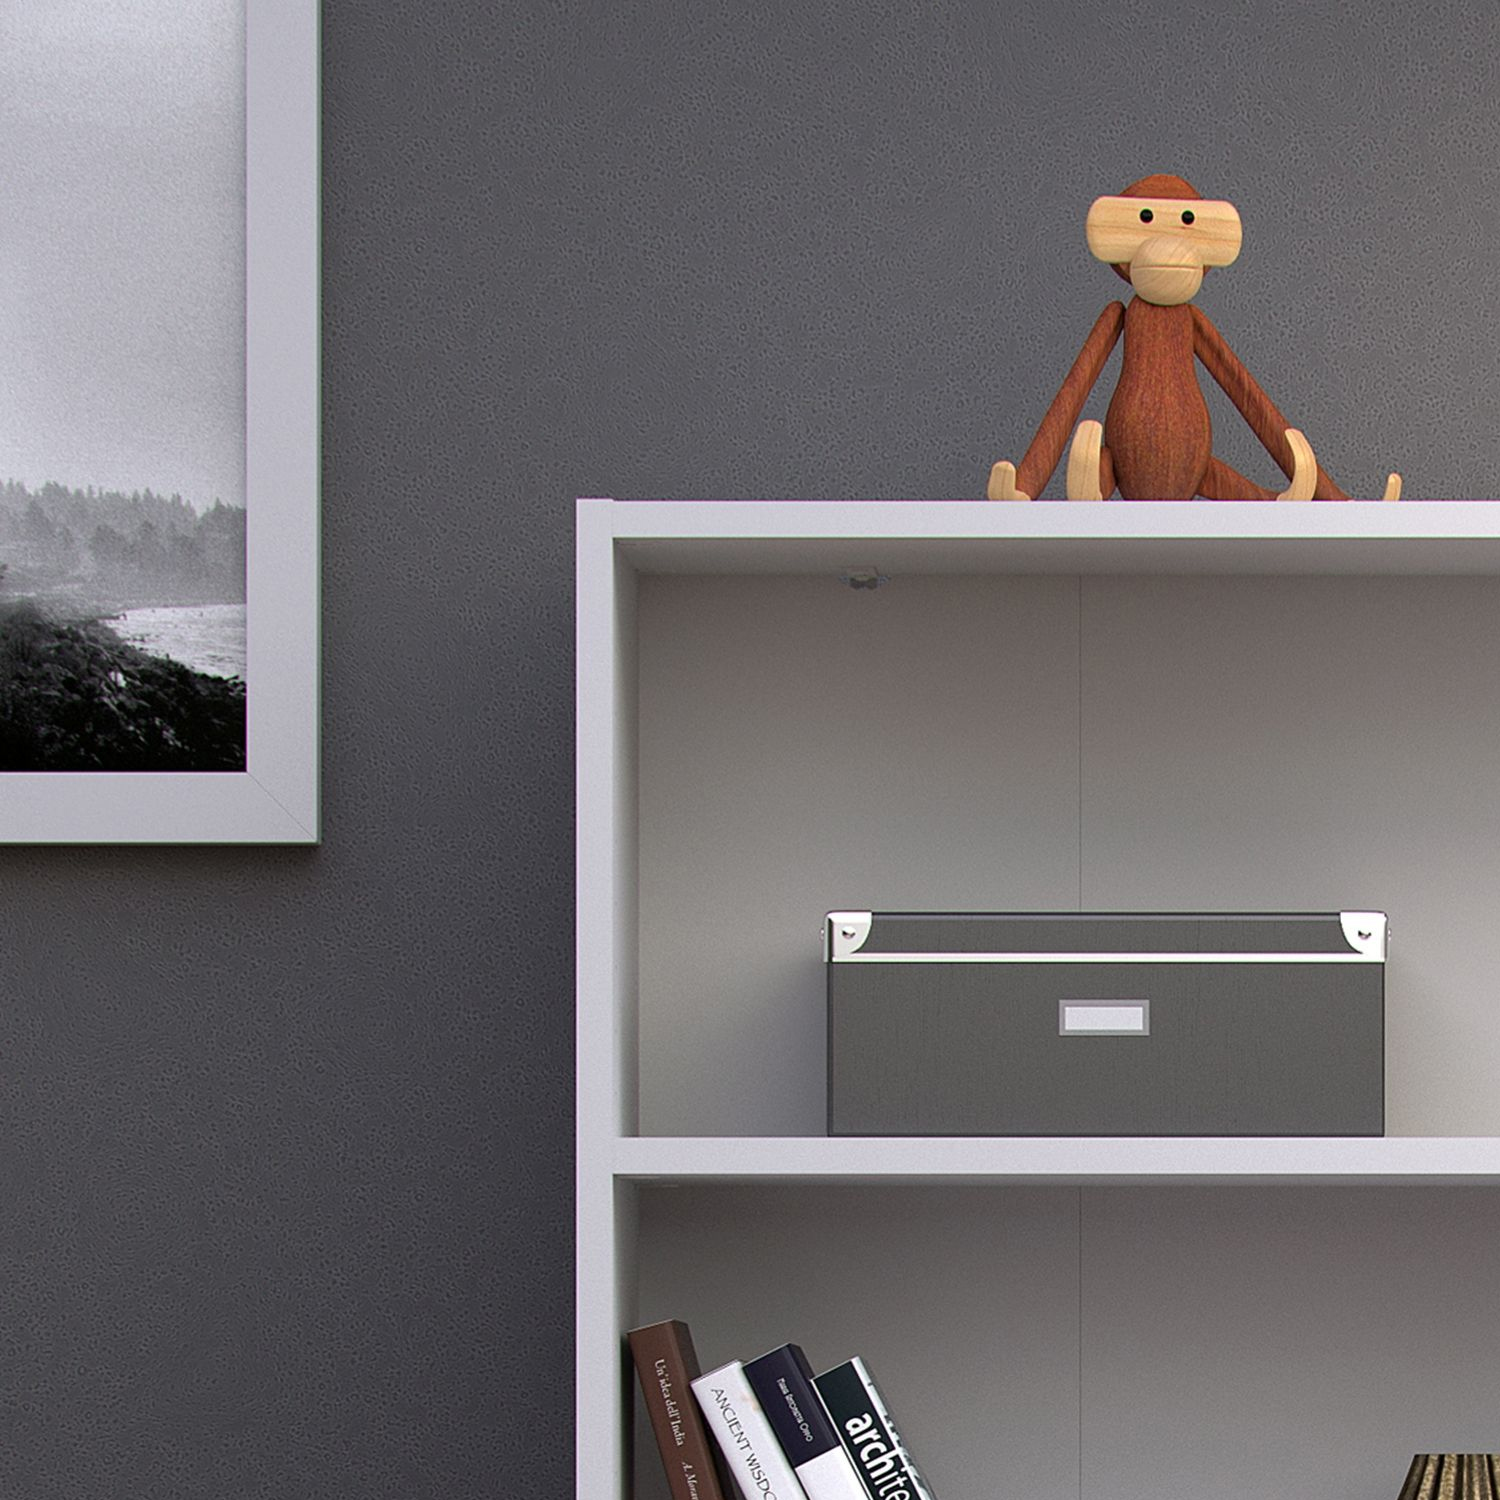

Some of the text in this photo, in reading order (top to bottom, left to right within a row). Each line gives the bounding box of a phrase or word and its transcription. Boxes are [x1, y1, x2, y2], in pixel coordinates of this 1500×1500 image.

[654, 1358, 685, 1445] Un'idea dell'India
[710, 1389, 752, 1450] ANCIENT
